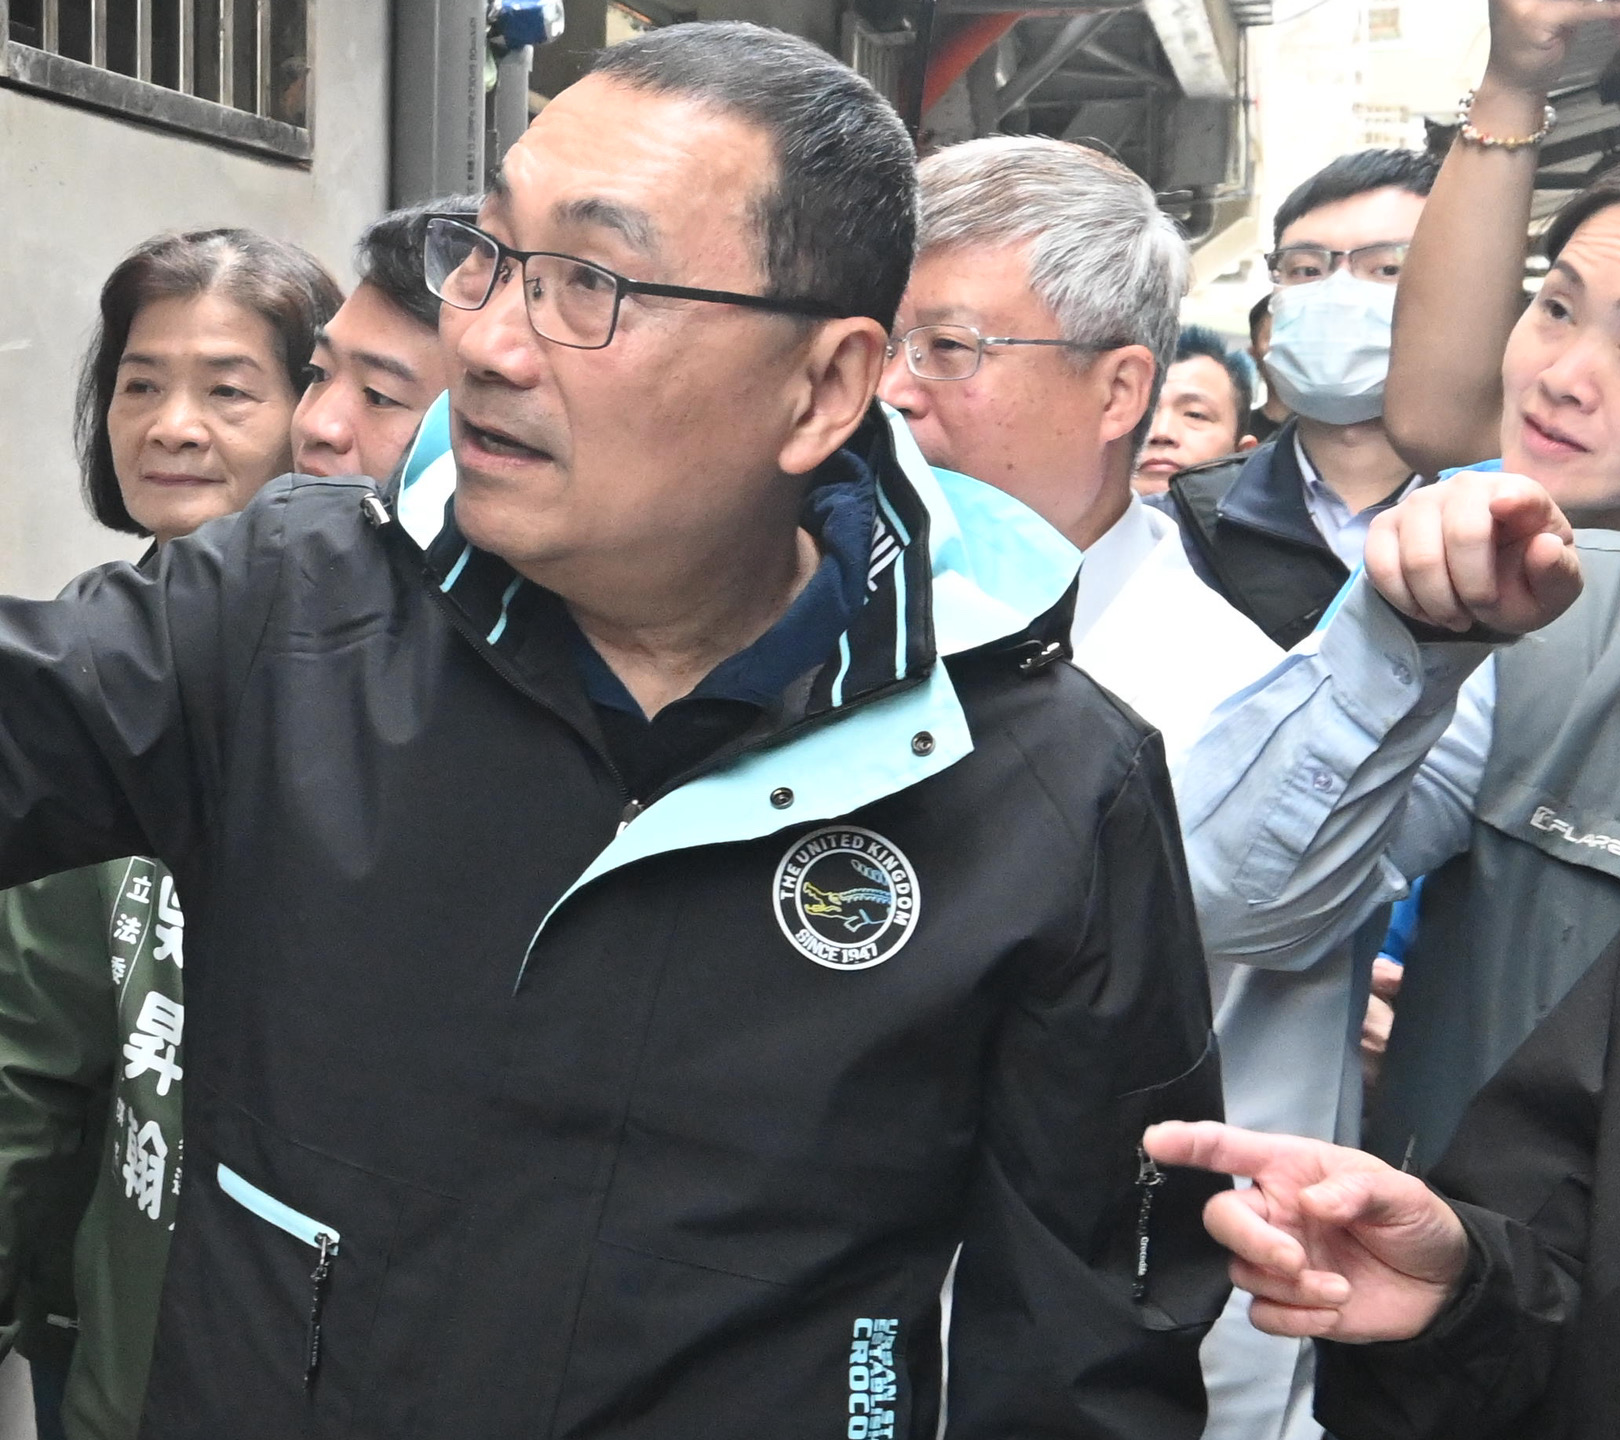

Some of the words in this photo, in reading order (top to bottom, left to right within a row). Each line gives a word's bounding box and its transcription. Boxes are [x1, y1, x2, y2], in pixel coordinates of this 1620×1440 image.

[780, 864, 801, 900] THE
[795, 833, 865, 864] UNITED
[867, 842, 912, 926] KINGDOM
[795, 928, 840, 962] SINCE
[841, 943, 878, 963] 1947
